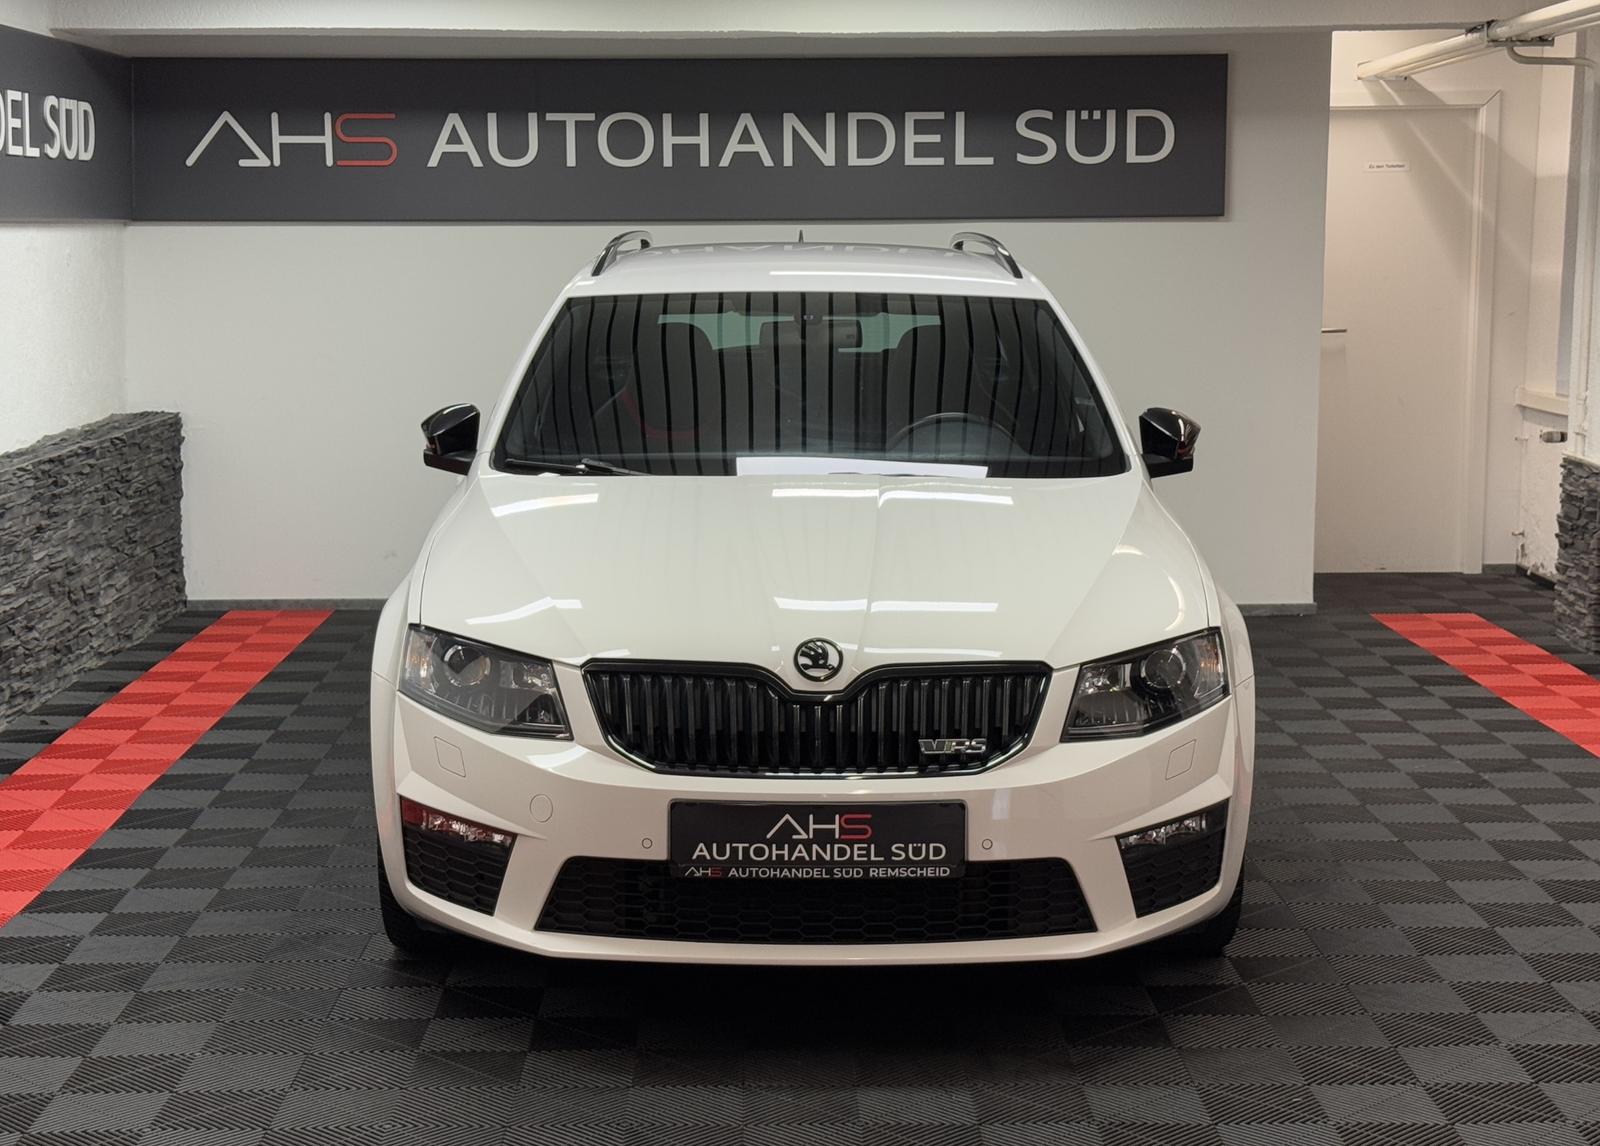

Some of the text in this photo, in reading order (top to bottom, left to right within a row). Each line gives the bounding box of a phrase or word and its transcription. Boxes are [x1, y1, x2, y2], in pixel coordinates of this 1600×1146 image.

[43, 95, 95, 161] SÜD
[185, 108, 1177, 169] AHS AUTOHANDEL SÜD
[766, 813, 872, 839] AHS
[692, 843, 946, 861] AUTOHANDEL SÜD
[728, 867, 831, 878] AUTOHANDEL
[833, 867, 863, 878] SÜD
[869, 867, 950, 878] REMSCHEID
